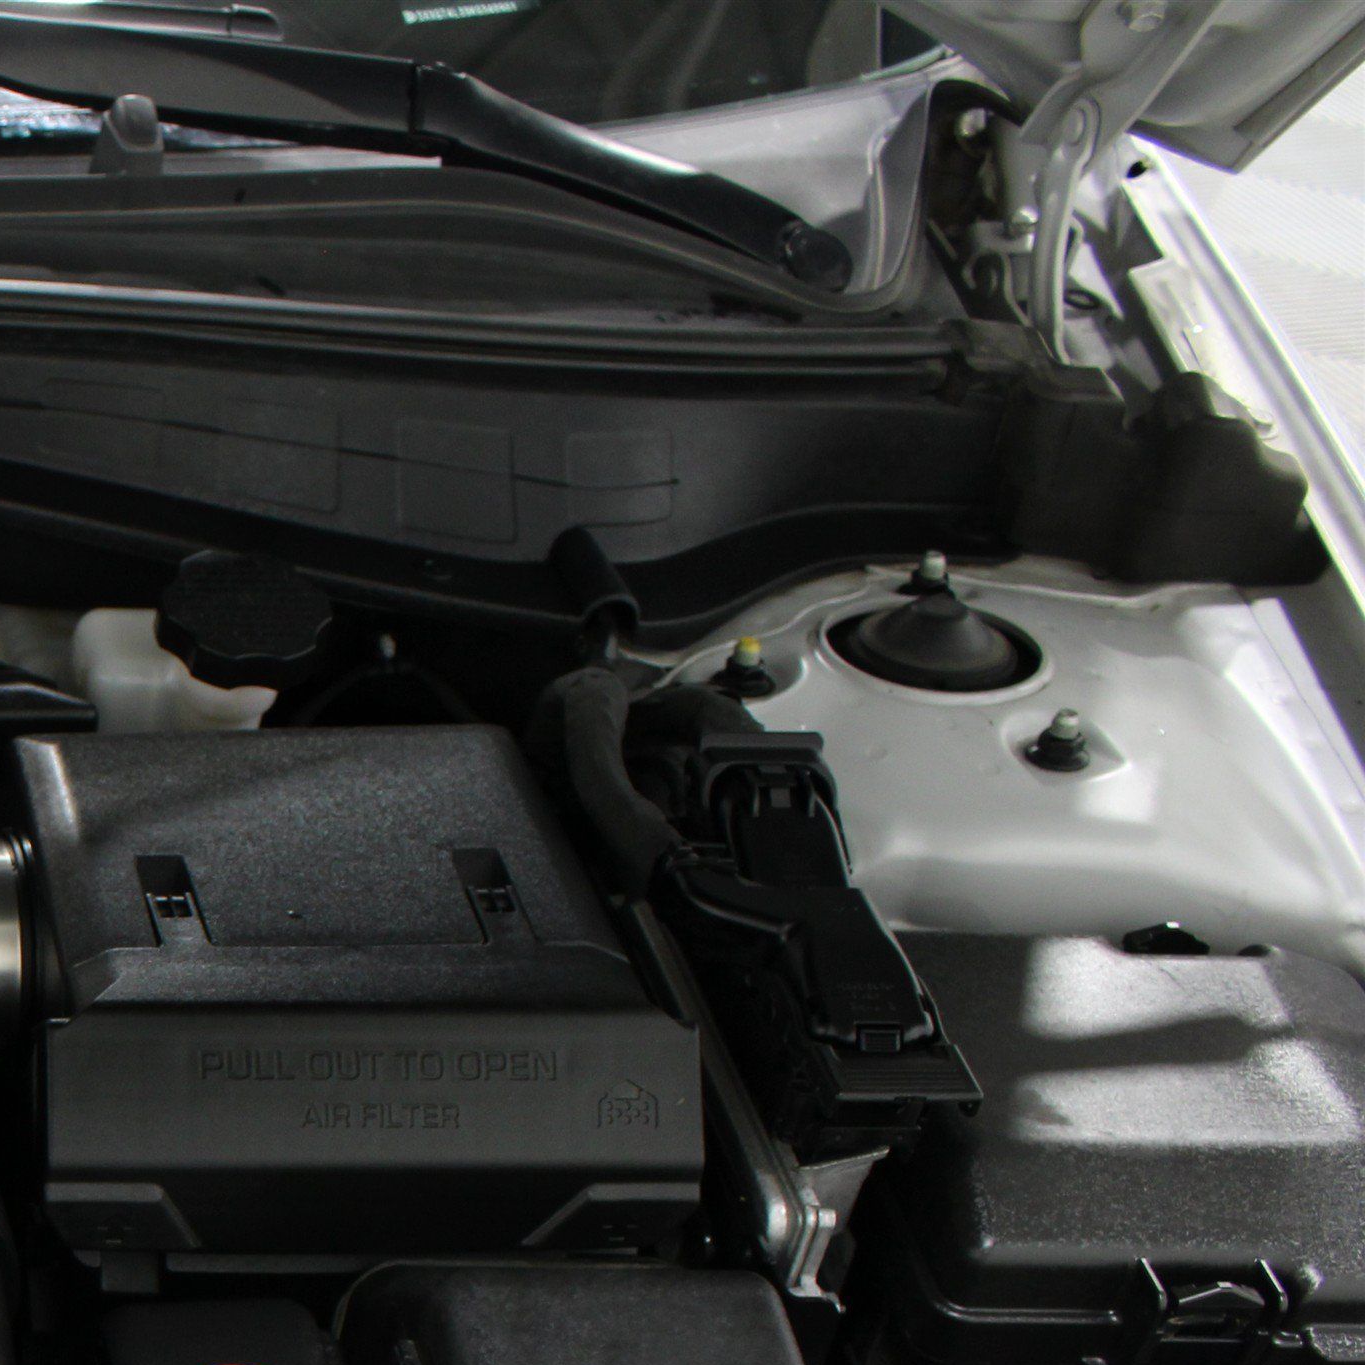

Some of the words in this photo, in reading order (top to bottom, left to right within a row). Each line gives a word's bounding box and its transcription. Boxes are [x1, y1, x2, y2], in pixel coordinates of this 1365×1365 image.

[198, 1049, 295, 1082] PULL
[305, 1049, 385, 1082] OUT
[393, 1049, 446, 1082] TO
[453, 1049, 558, 1082] OPEN
[302, 1103, 353, 1129] AIR
[362, 1103, 462, 1130] FILTER
